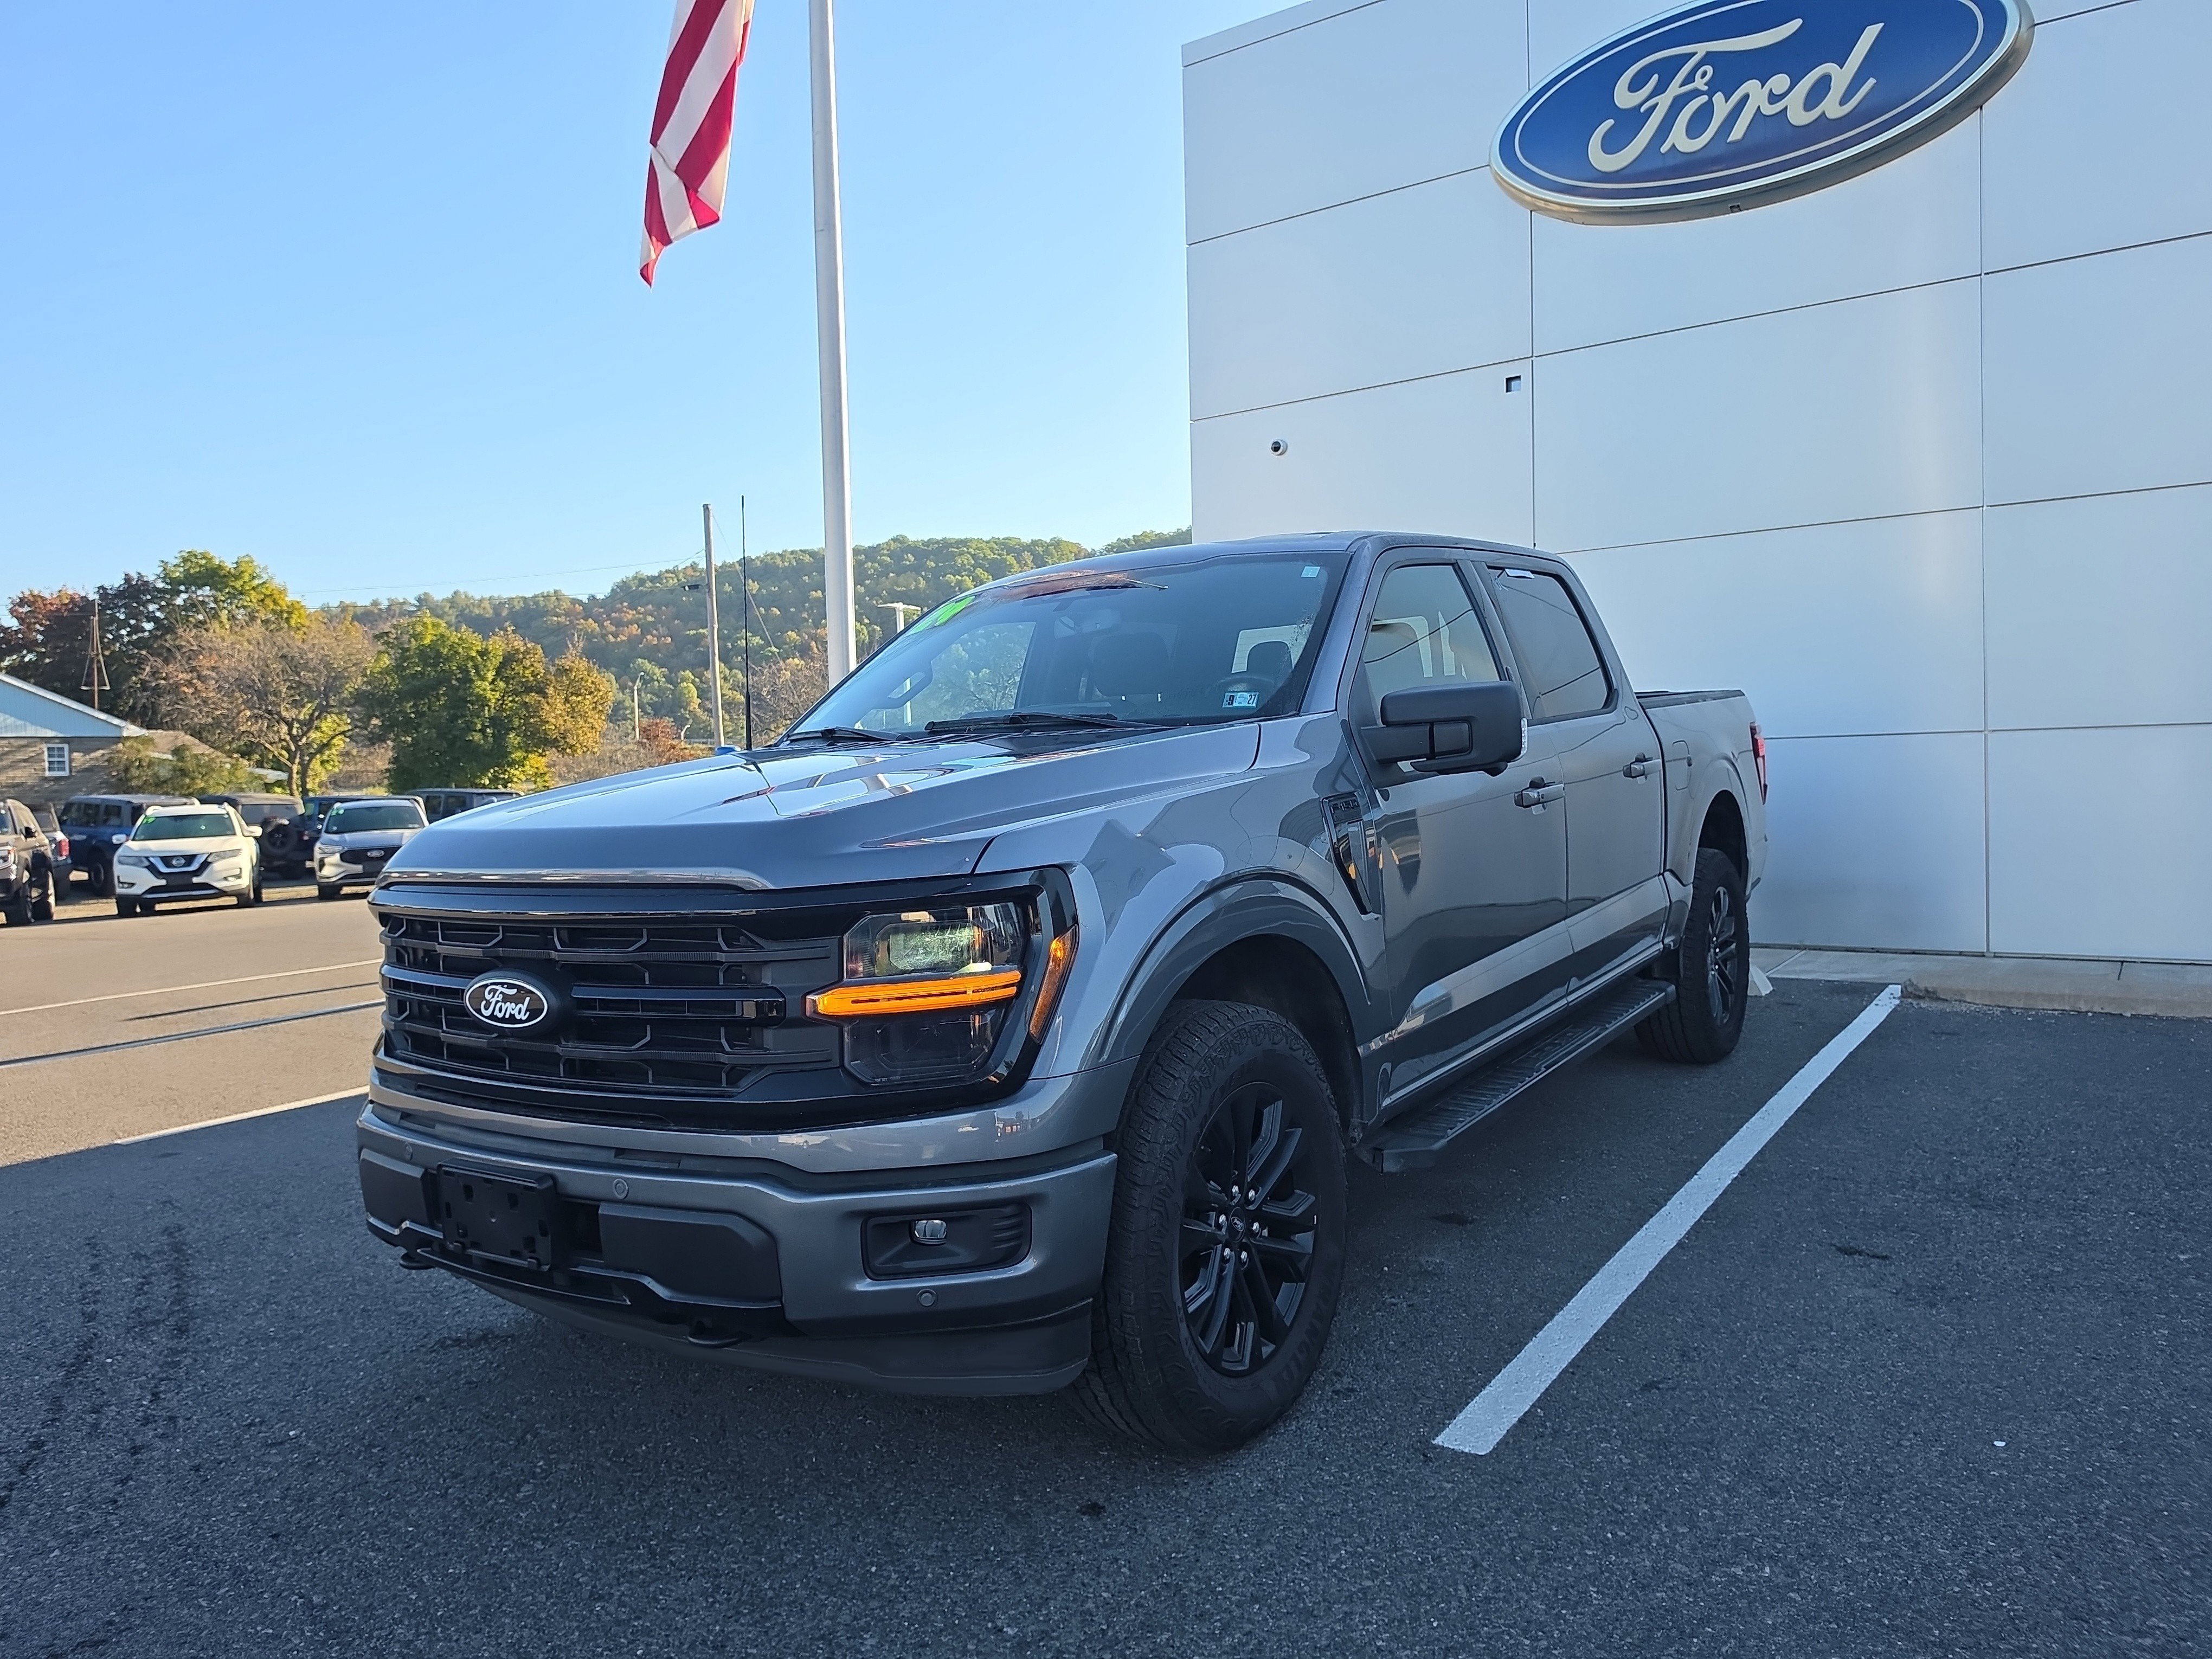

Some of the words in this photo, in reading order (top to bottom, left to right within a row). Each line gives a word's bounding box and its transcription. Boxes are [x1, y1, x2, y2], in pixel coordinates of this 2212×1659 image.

[1589, 18, 1885, 172] Ford
[1227, 695, 1234, 705] 9
[1248, 694, 1256, 705] 27
[481, 985, 530, 1020] Ford
